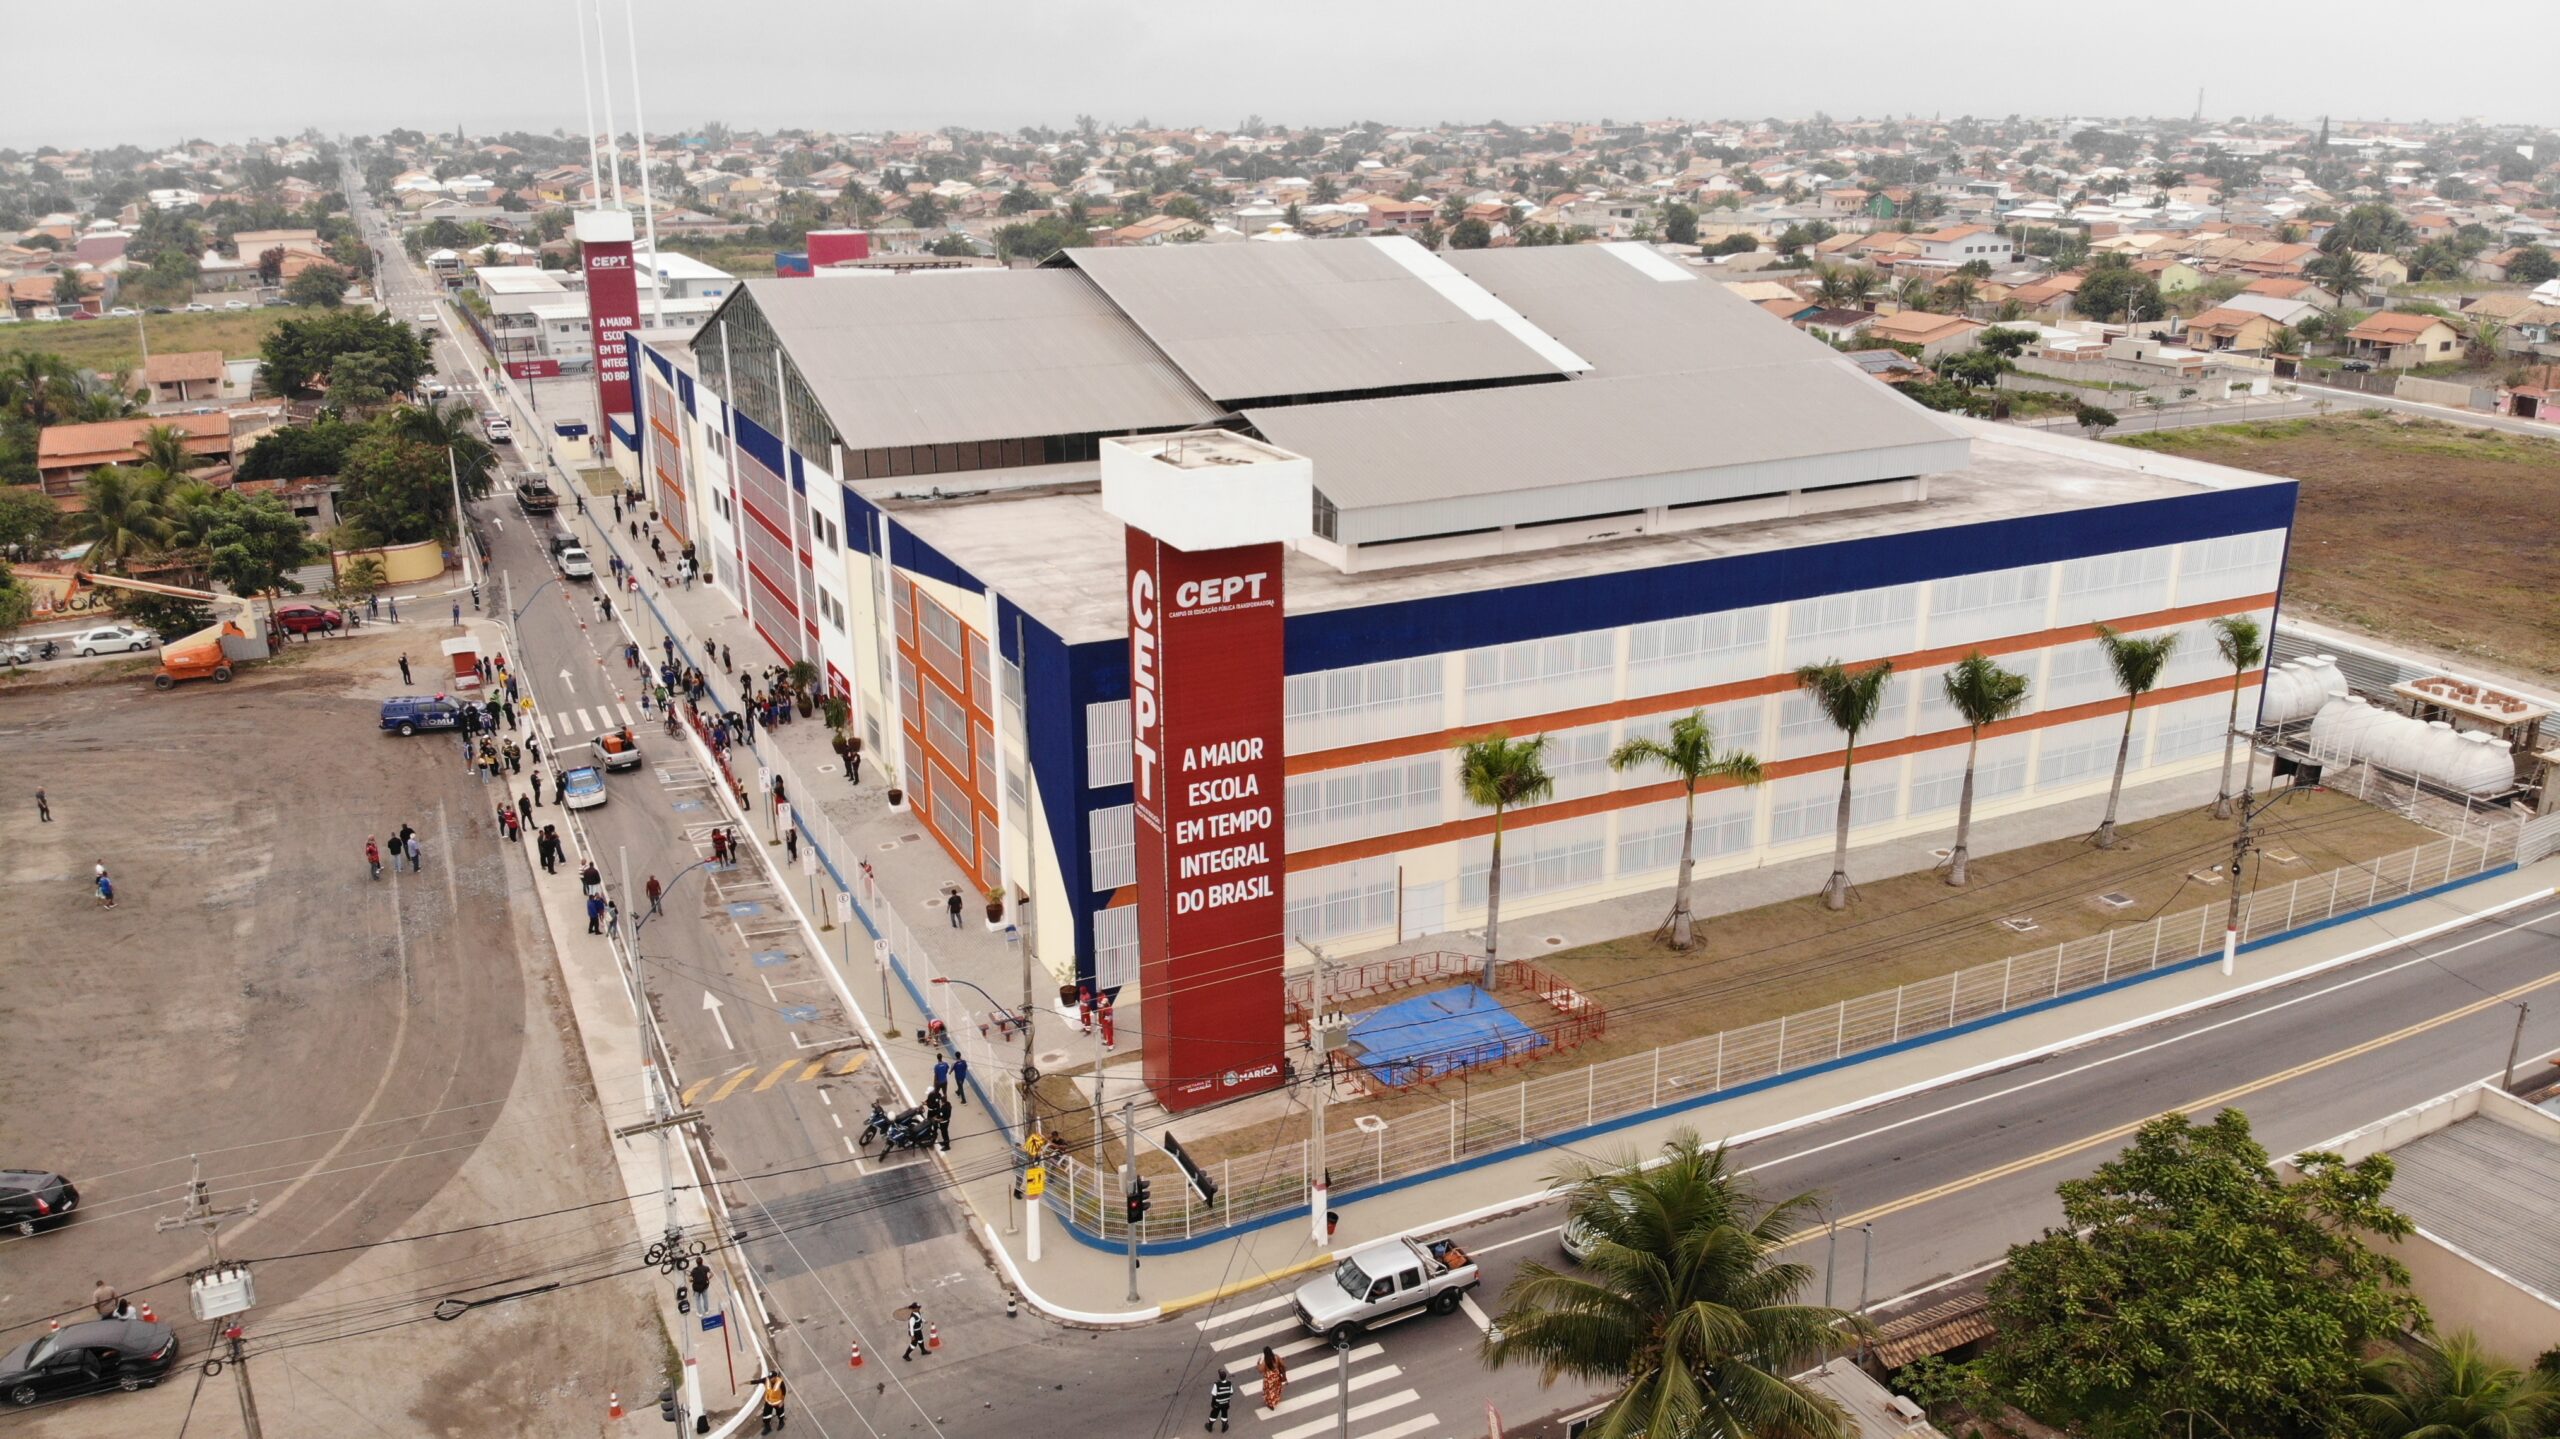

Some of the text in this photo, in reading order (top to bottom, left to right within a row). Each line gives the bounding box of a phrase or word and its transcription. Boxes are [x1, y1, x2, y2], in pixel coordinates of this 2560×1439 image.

[592, 255, 627, 267] CEPT
[599, 316, 632, 327] A MAIOR
[603, 330, 625, 341] ESCOL
[600, 343, 627, 354] EM TEM
[602, 357, 628, 368] INTEGR
[602, 370, 630, 381] DO BRA
[1176, 572, 1267, 608] CEPT
[1132, 569, 1157, 801] CEPT
[1182, 737, 1263, 772] A MAIOR
[1188, 774, 1259, 807] ESCOLA
[1176, 817, 1204, 845] EM
[1208, 806, 1272, 837] TEMPO
[1180, 842, 1270, 879] INTEGRAL
[1177, 875, 1274, 915] DO BRASIL
